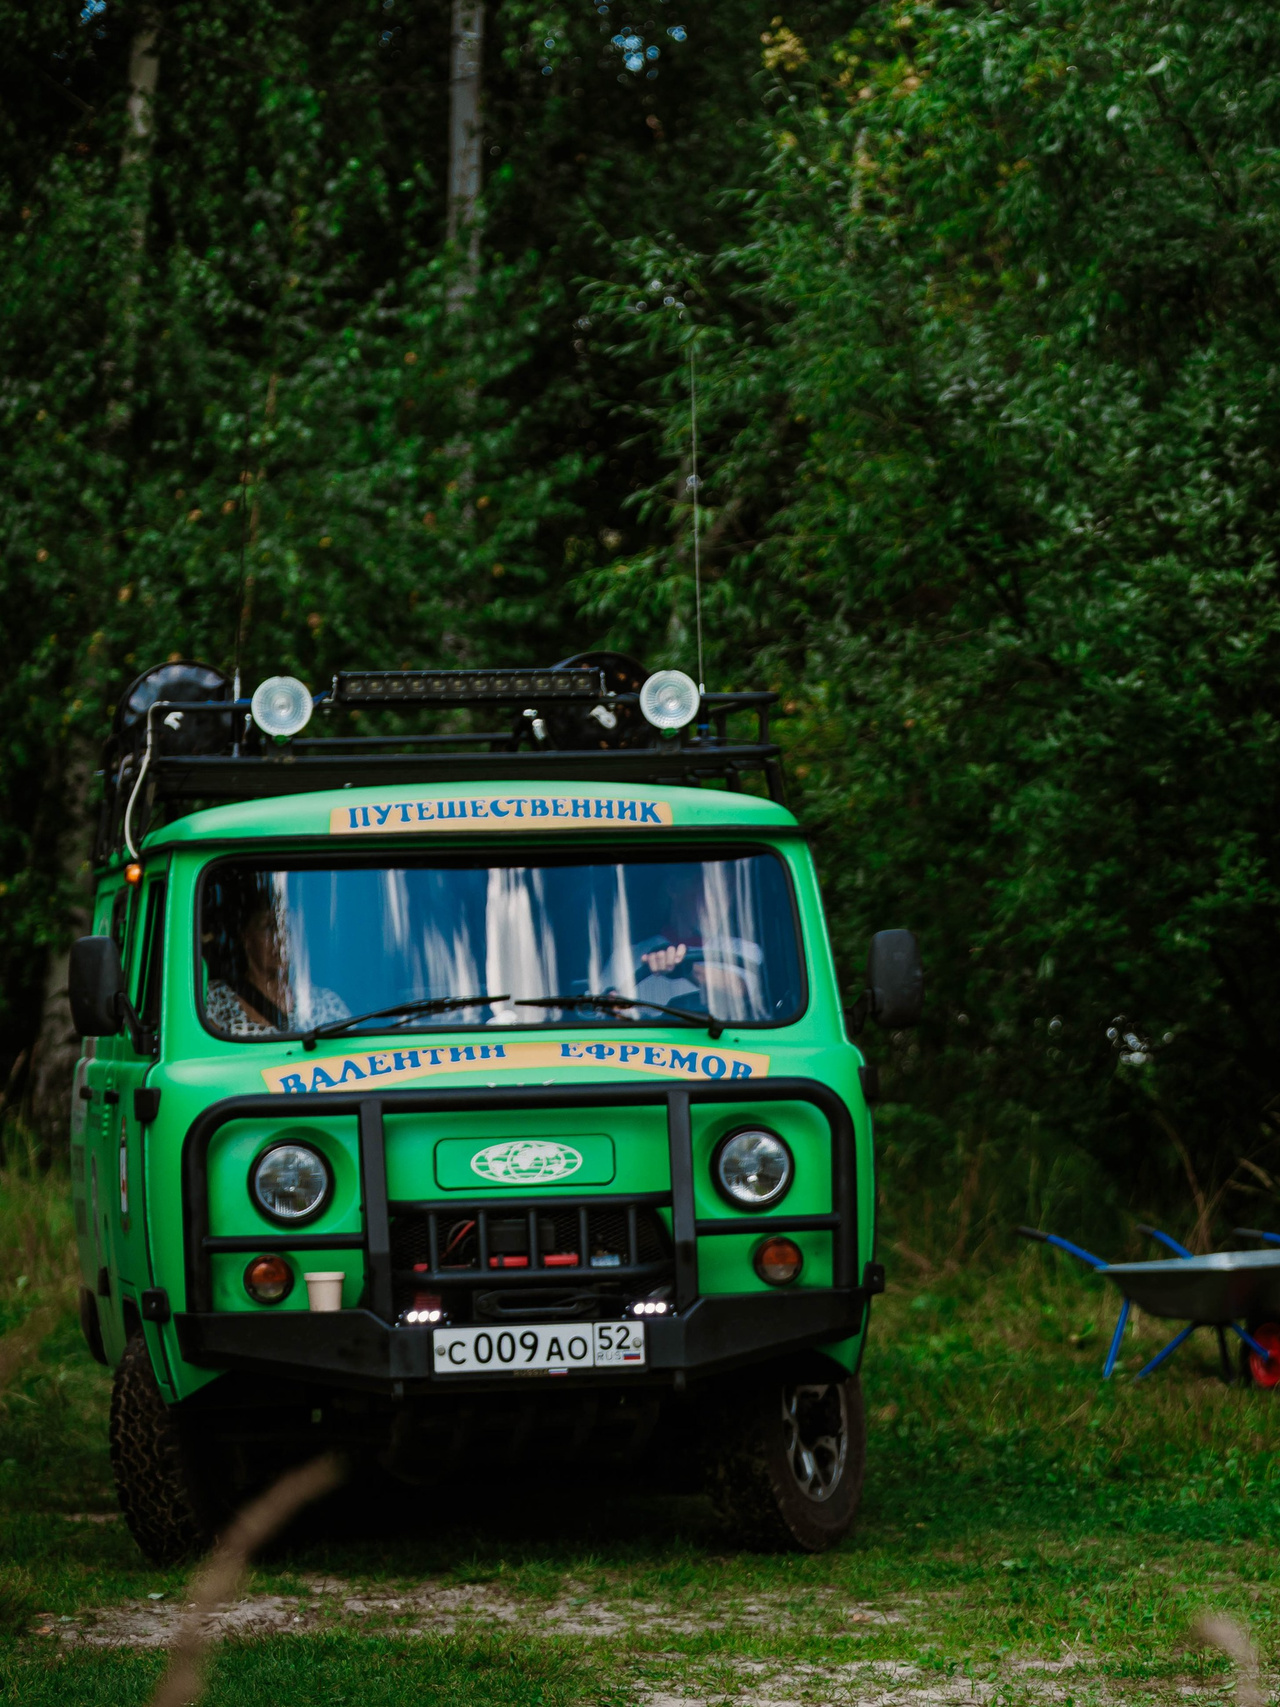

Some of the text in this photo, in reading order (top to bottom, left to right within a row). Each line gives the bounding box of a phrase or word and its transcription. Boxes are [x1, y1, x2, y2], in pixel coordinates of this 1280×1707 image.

[349, 799, 662, 828] ПУТЕШЕСТВЕННИК
[279, 1043, 753, 1093] ВАЛЕНТИН ЕФРЕМОВ
[598, 1326, 631, 1350] 52
[597, 1351, 622, 1361] RUS
